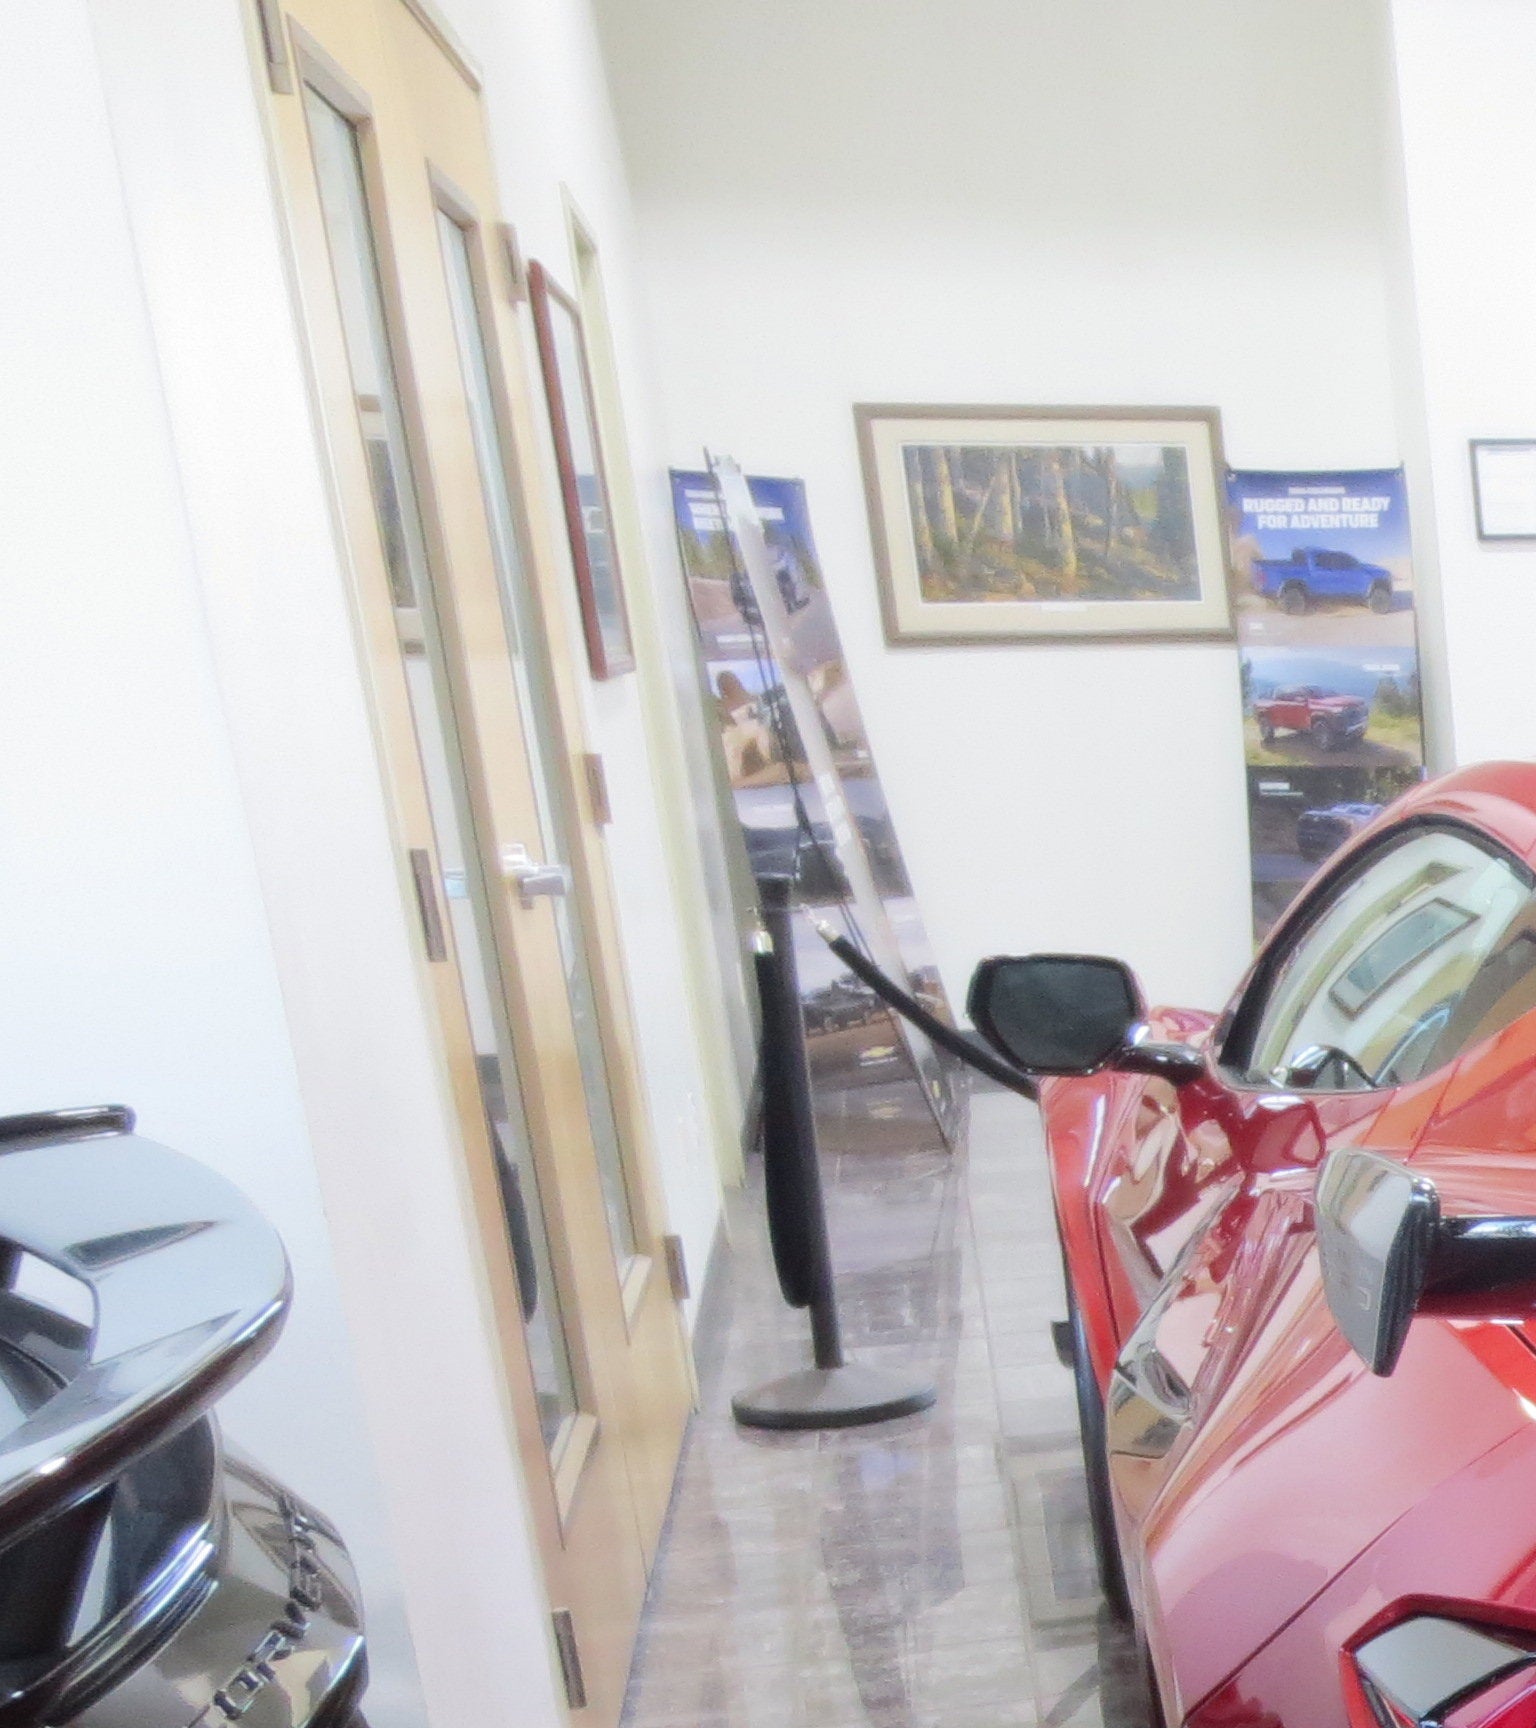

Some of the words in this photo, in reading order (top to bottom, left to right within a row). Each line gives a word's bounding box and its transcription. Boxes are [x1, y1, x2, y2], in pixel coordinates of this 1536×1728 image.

[1242, 497, 1305, 513] RUGGED
[1308, 497, 1339, 512] AND
[1342, 496, 1391, 512] READY
[1257, 514, 1288, 530] FOR
[1291, 513, 1379, 529] ADVENTURE
